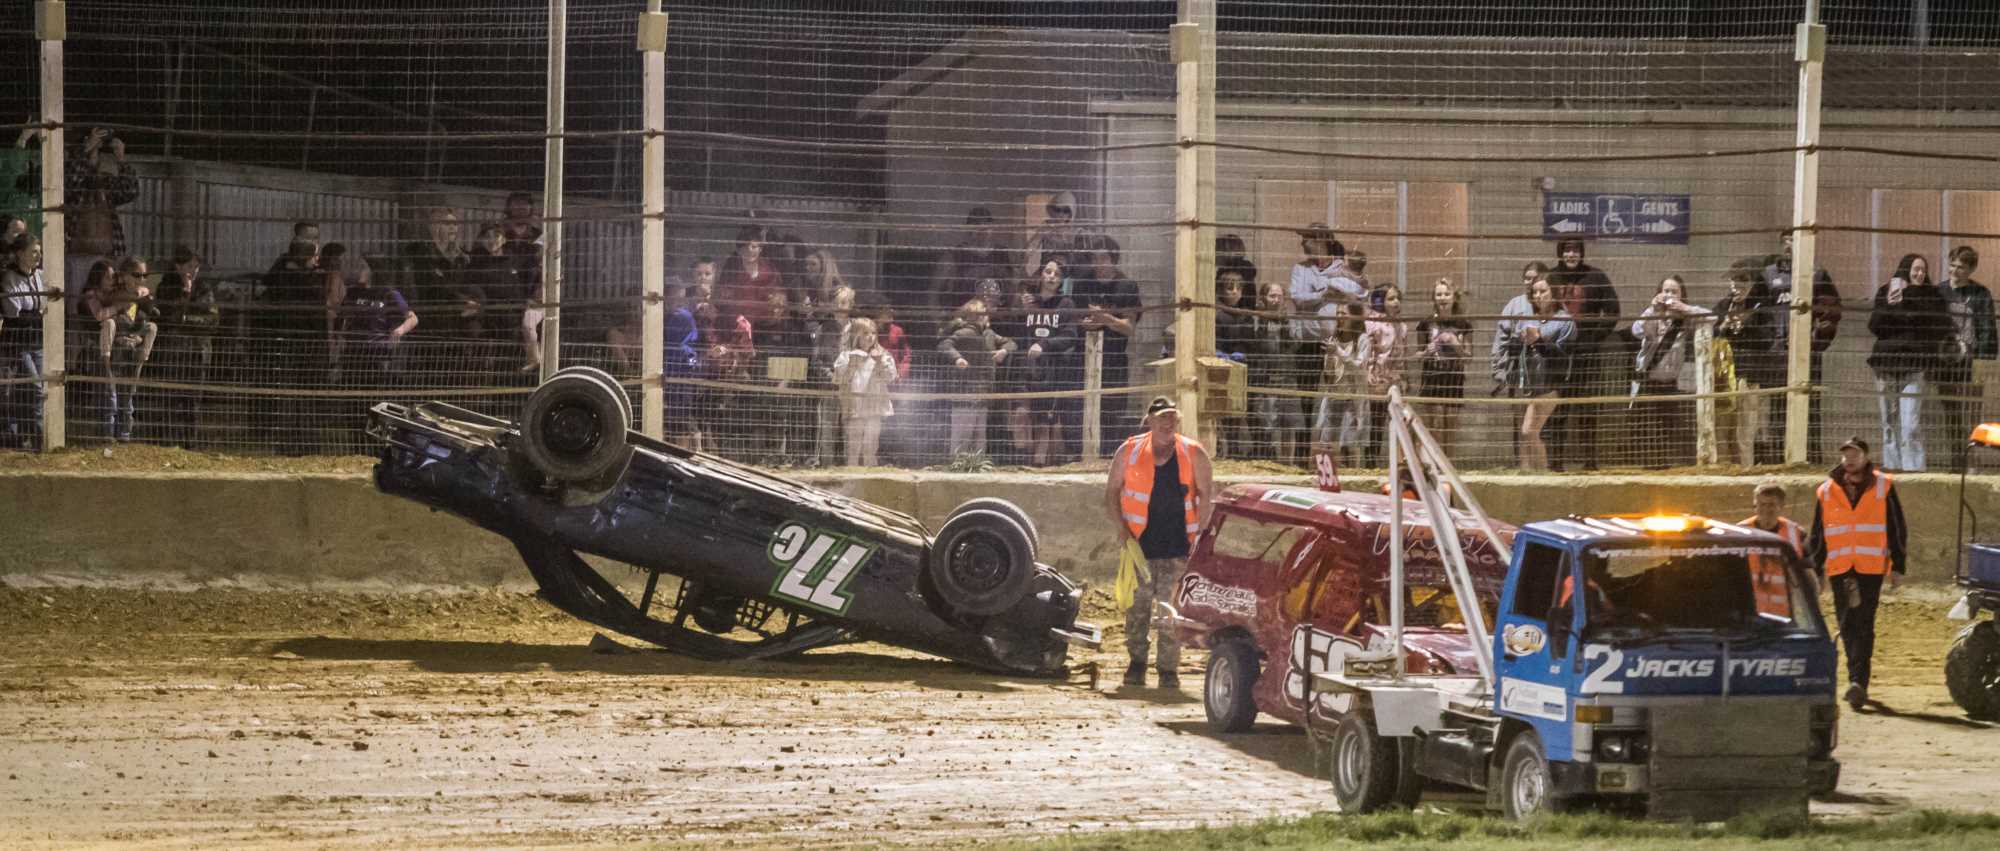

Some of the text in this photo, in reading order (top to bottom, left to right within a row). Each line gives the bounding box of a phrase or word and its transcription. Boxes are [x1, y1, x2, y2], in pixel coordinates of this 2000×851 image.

[1553, 201, 1590, 215] LADIES
[1642, 201, 1679, 216] GENTS
[1579, 643, 1625, 694] 2
[1625, 655, 1715, 678] JACKS
[1725, 657, 1806, 677] TYRES
